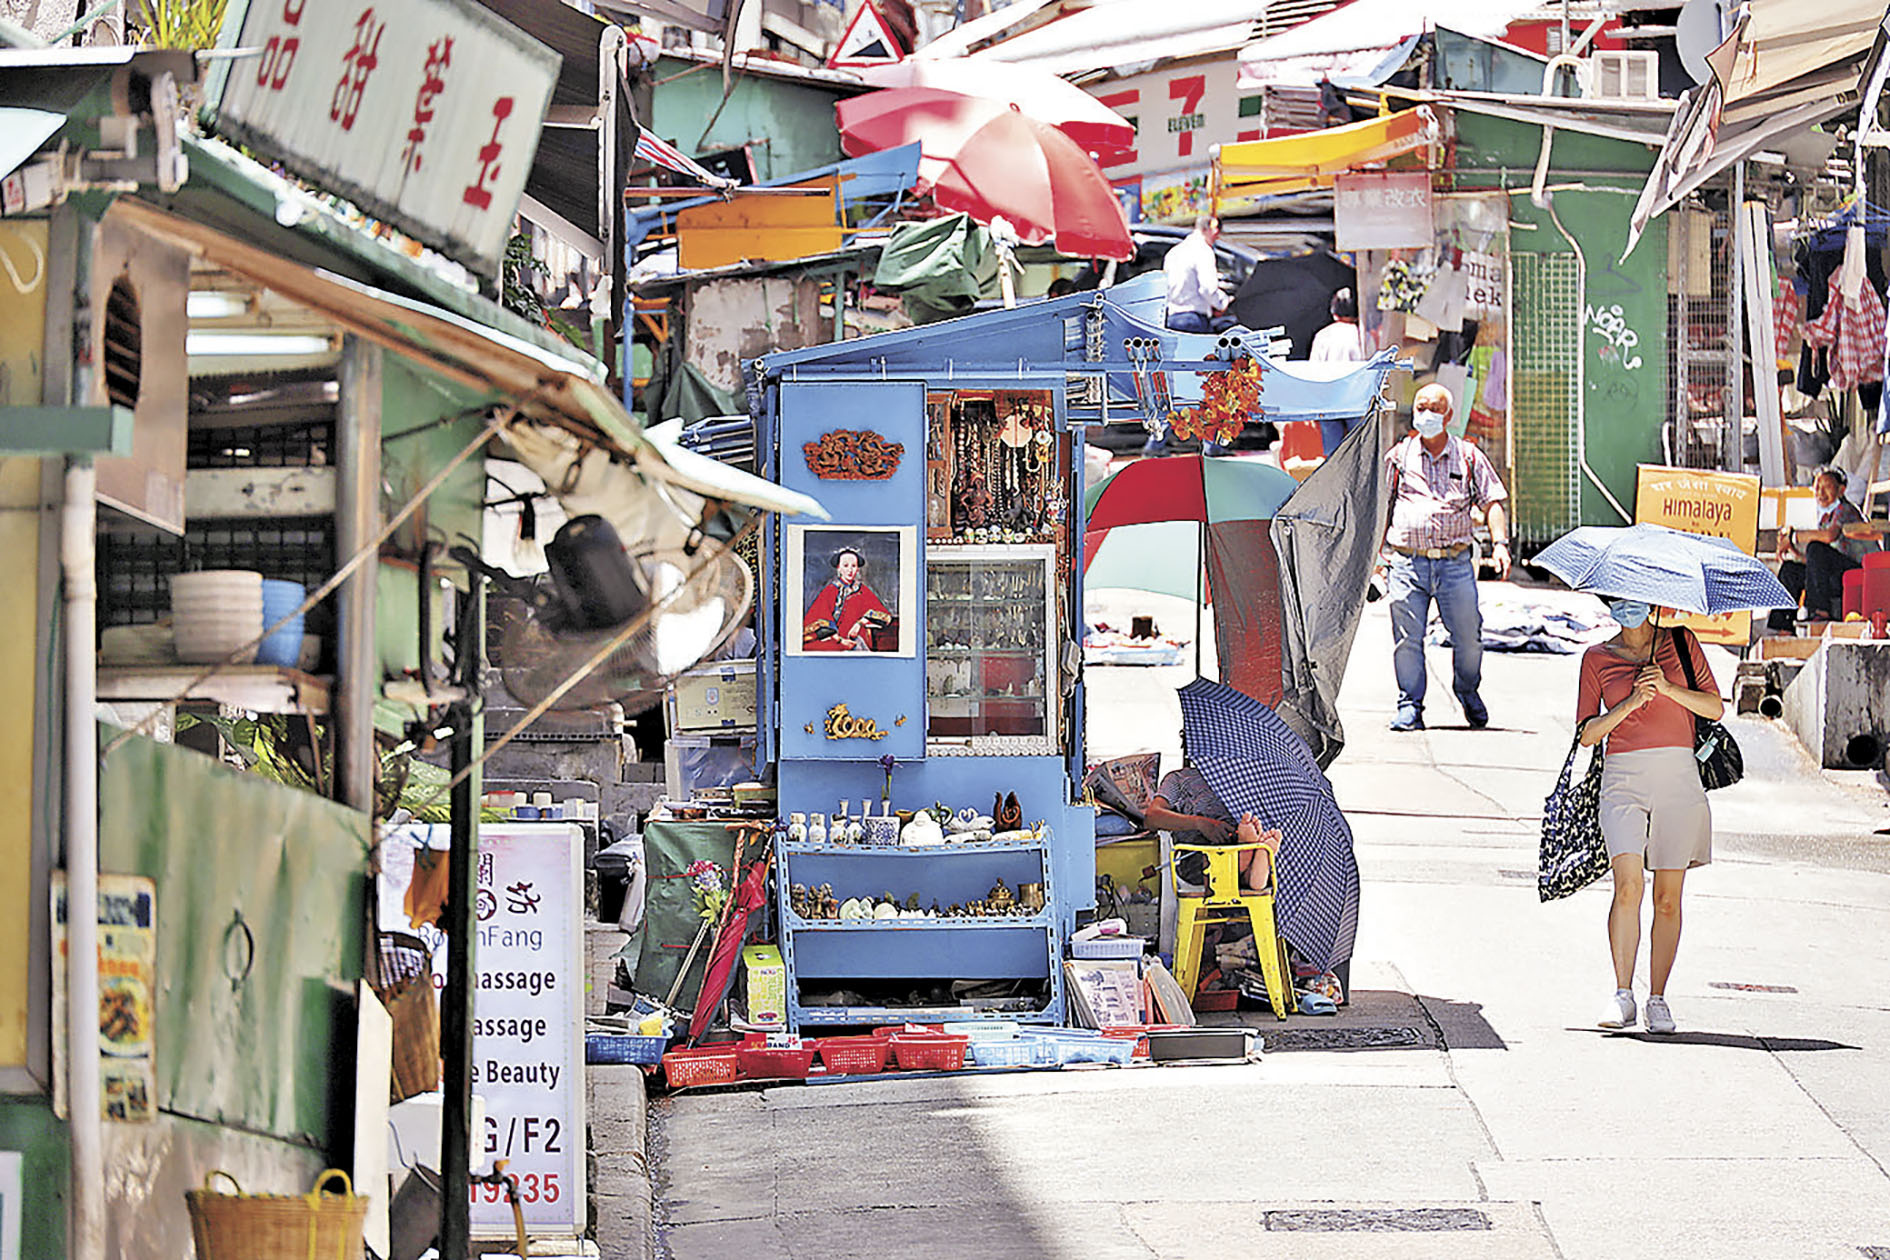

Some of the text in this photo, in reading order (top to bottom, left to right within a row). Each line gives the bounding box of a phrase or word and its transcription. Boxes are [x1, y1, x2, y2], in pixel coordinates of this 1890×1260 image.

[1169, 74, 1206, 158] 7
[473, 1018, 547, 1043] assage
[486, 1060, 561, 1090] Beauty
